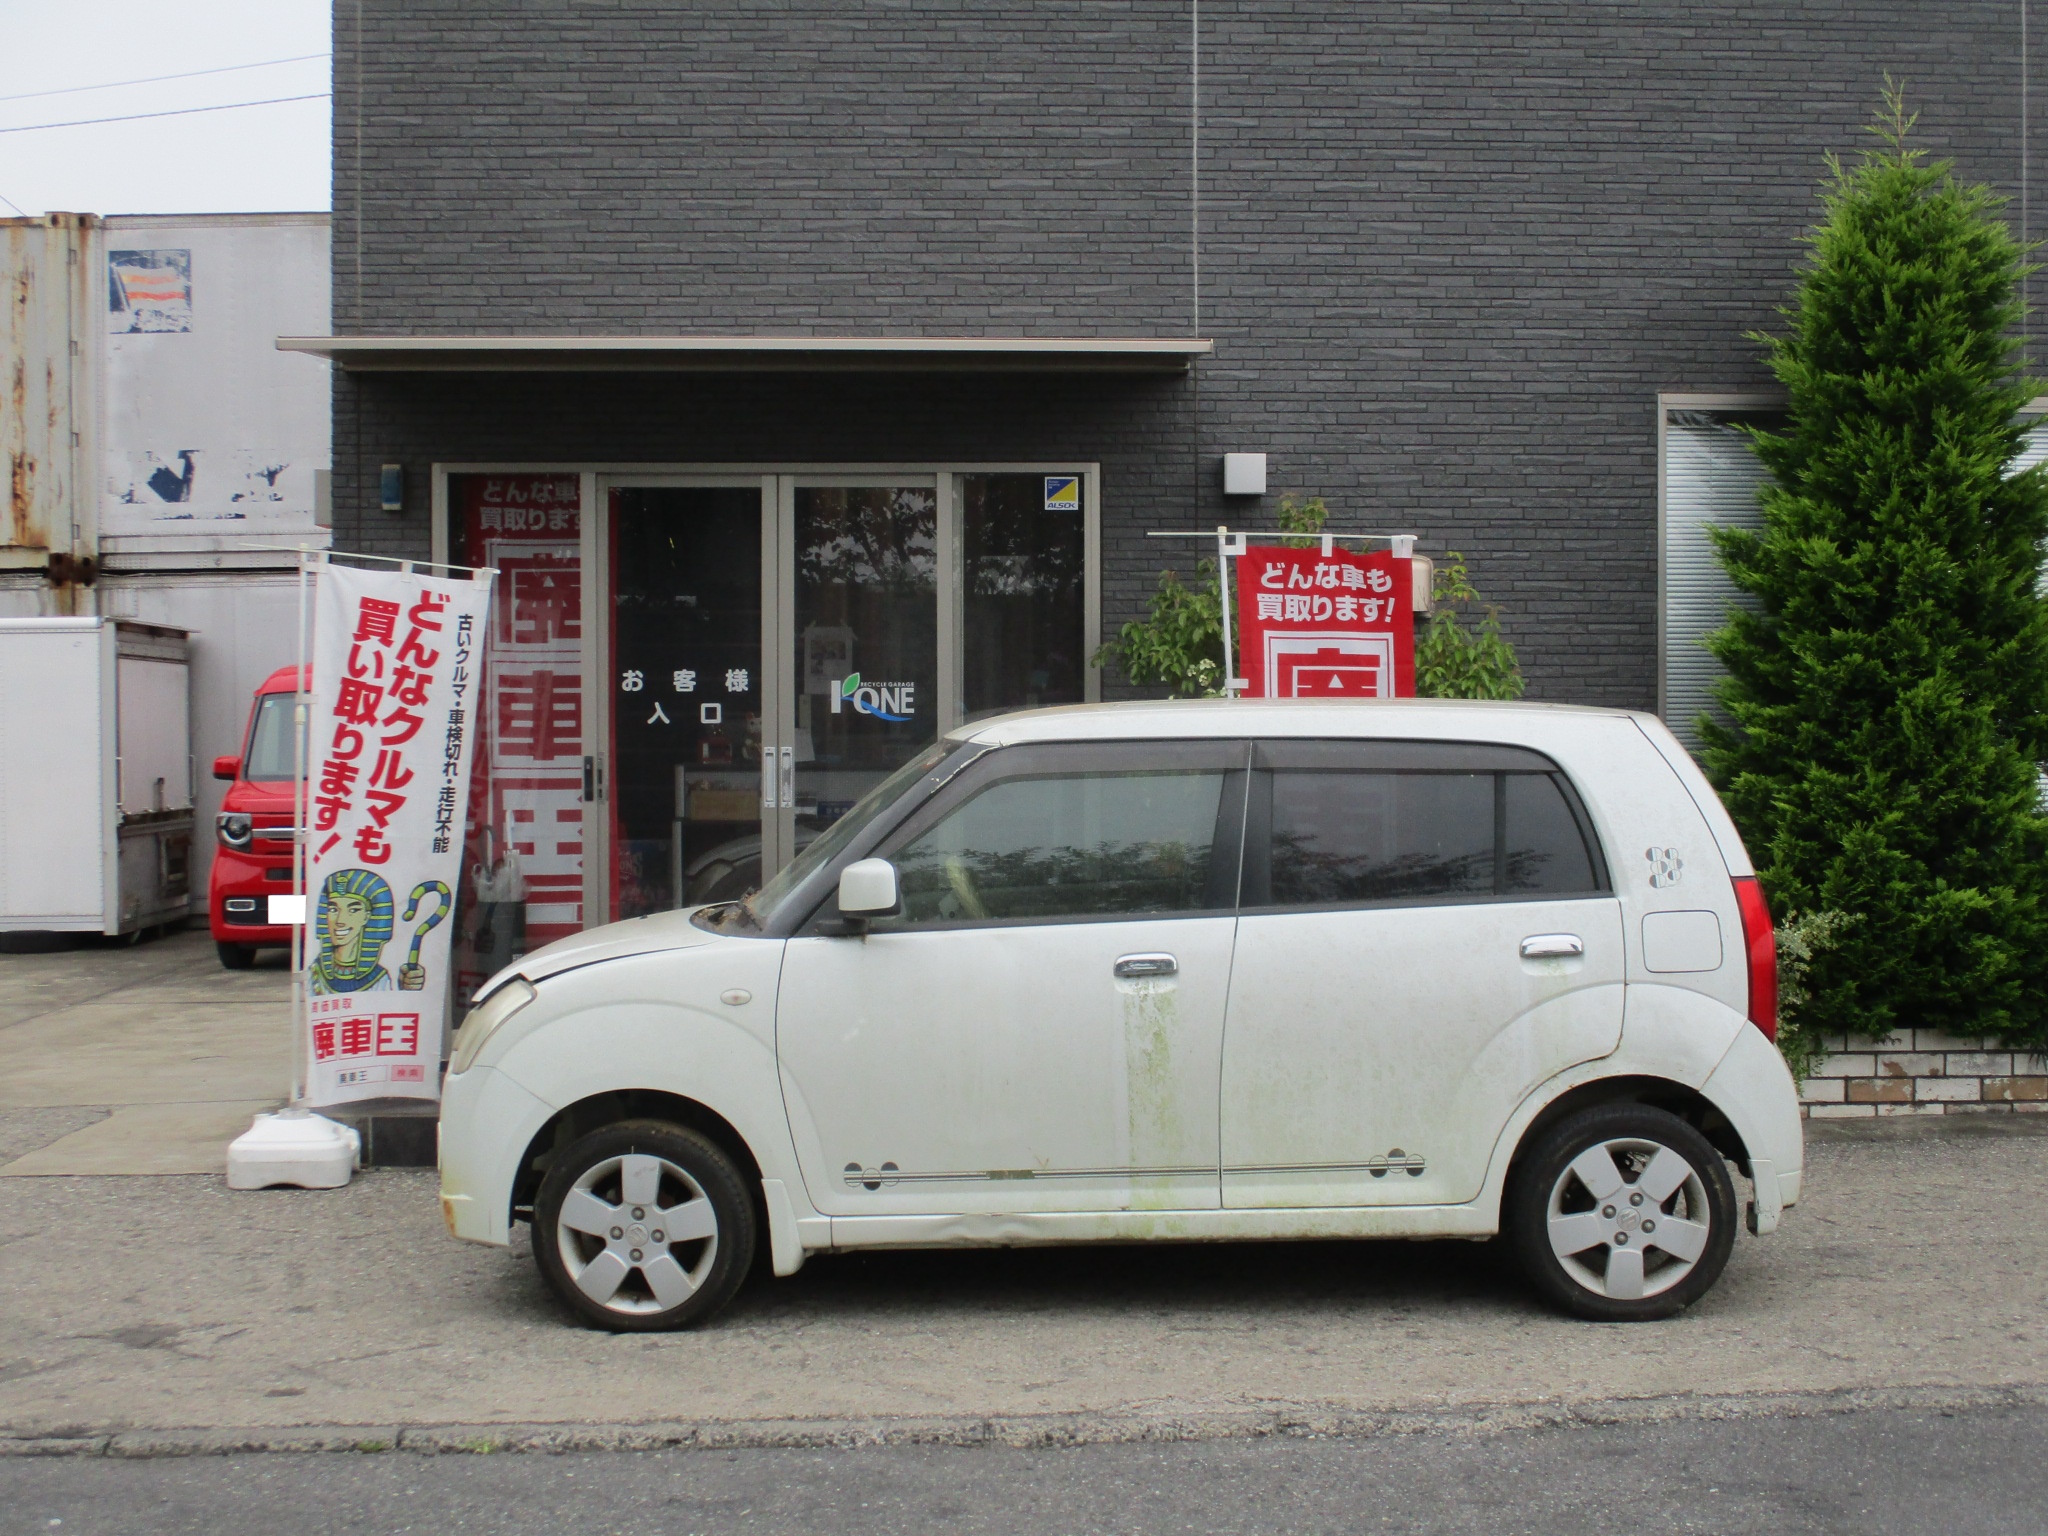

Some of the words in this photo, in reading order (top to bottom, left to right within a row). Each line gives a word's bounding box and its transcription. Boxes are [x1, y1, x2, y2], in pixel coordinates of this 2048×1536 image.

[483, 480, 580, 503] どんな車
[1260, 562, 1393, 593] どんな車も
[1256, 593, 1396, 623] 買取ります!
[621, 668, 749, 692] お客様
[352, 589, 451, 865] どんなクルマも
[647, 702, 722, 724] 入口
[313, 596, 401, 864] 買い取ります!
[432, 613, 474, 854] 古いクルマ・車検切れ・走行不能
